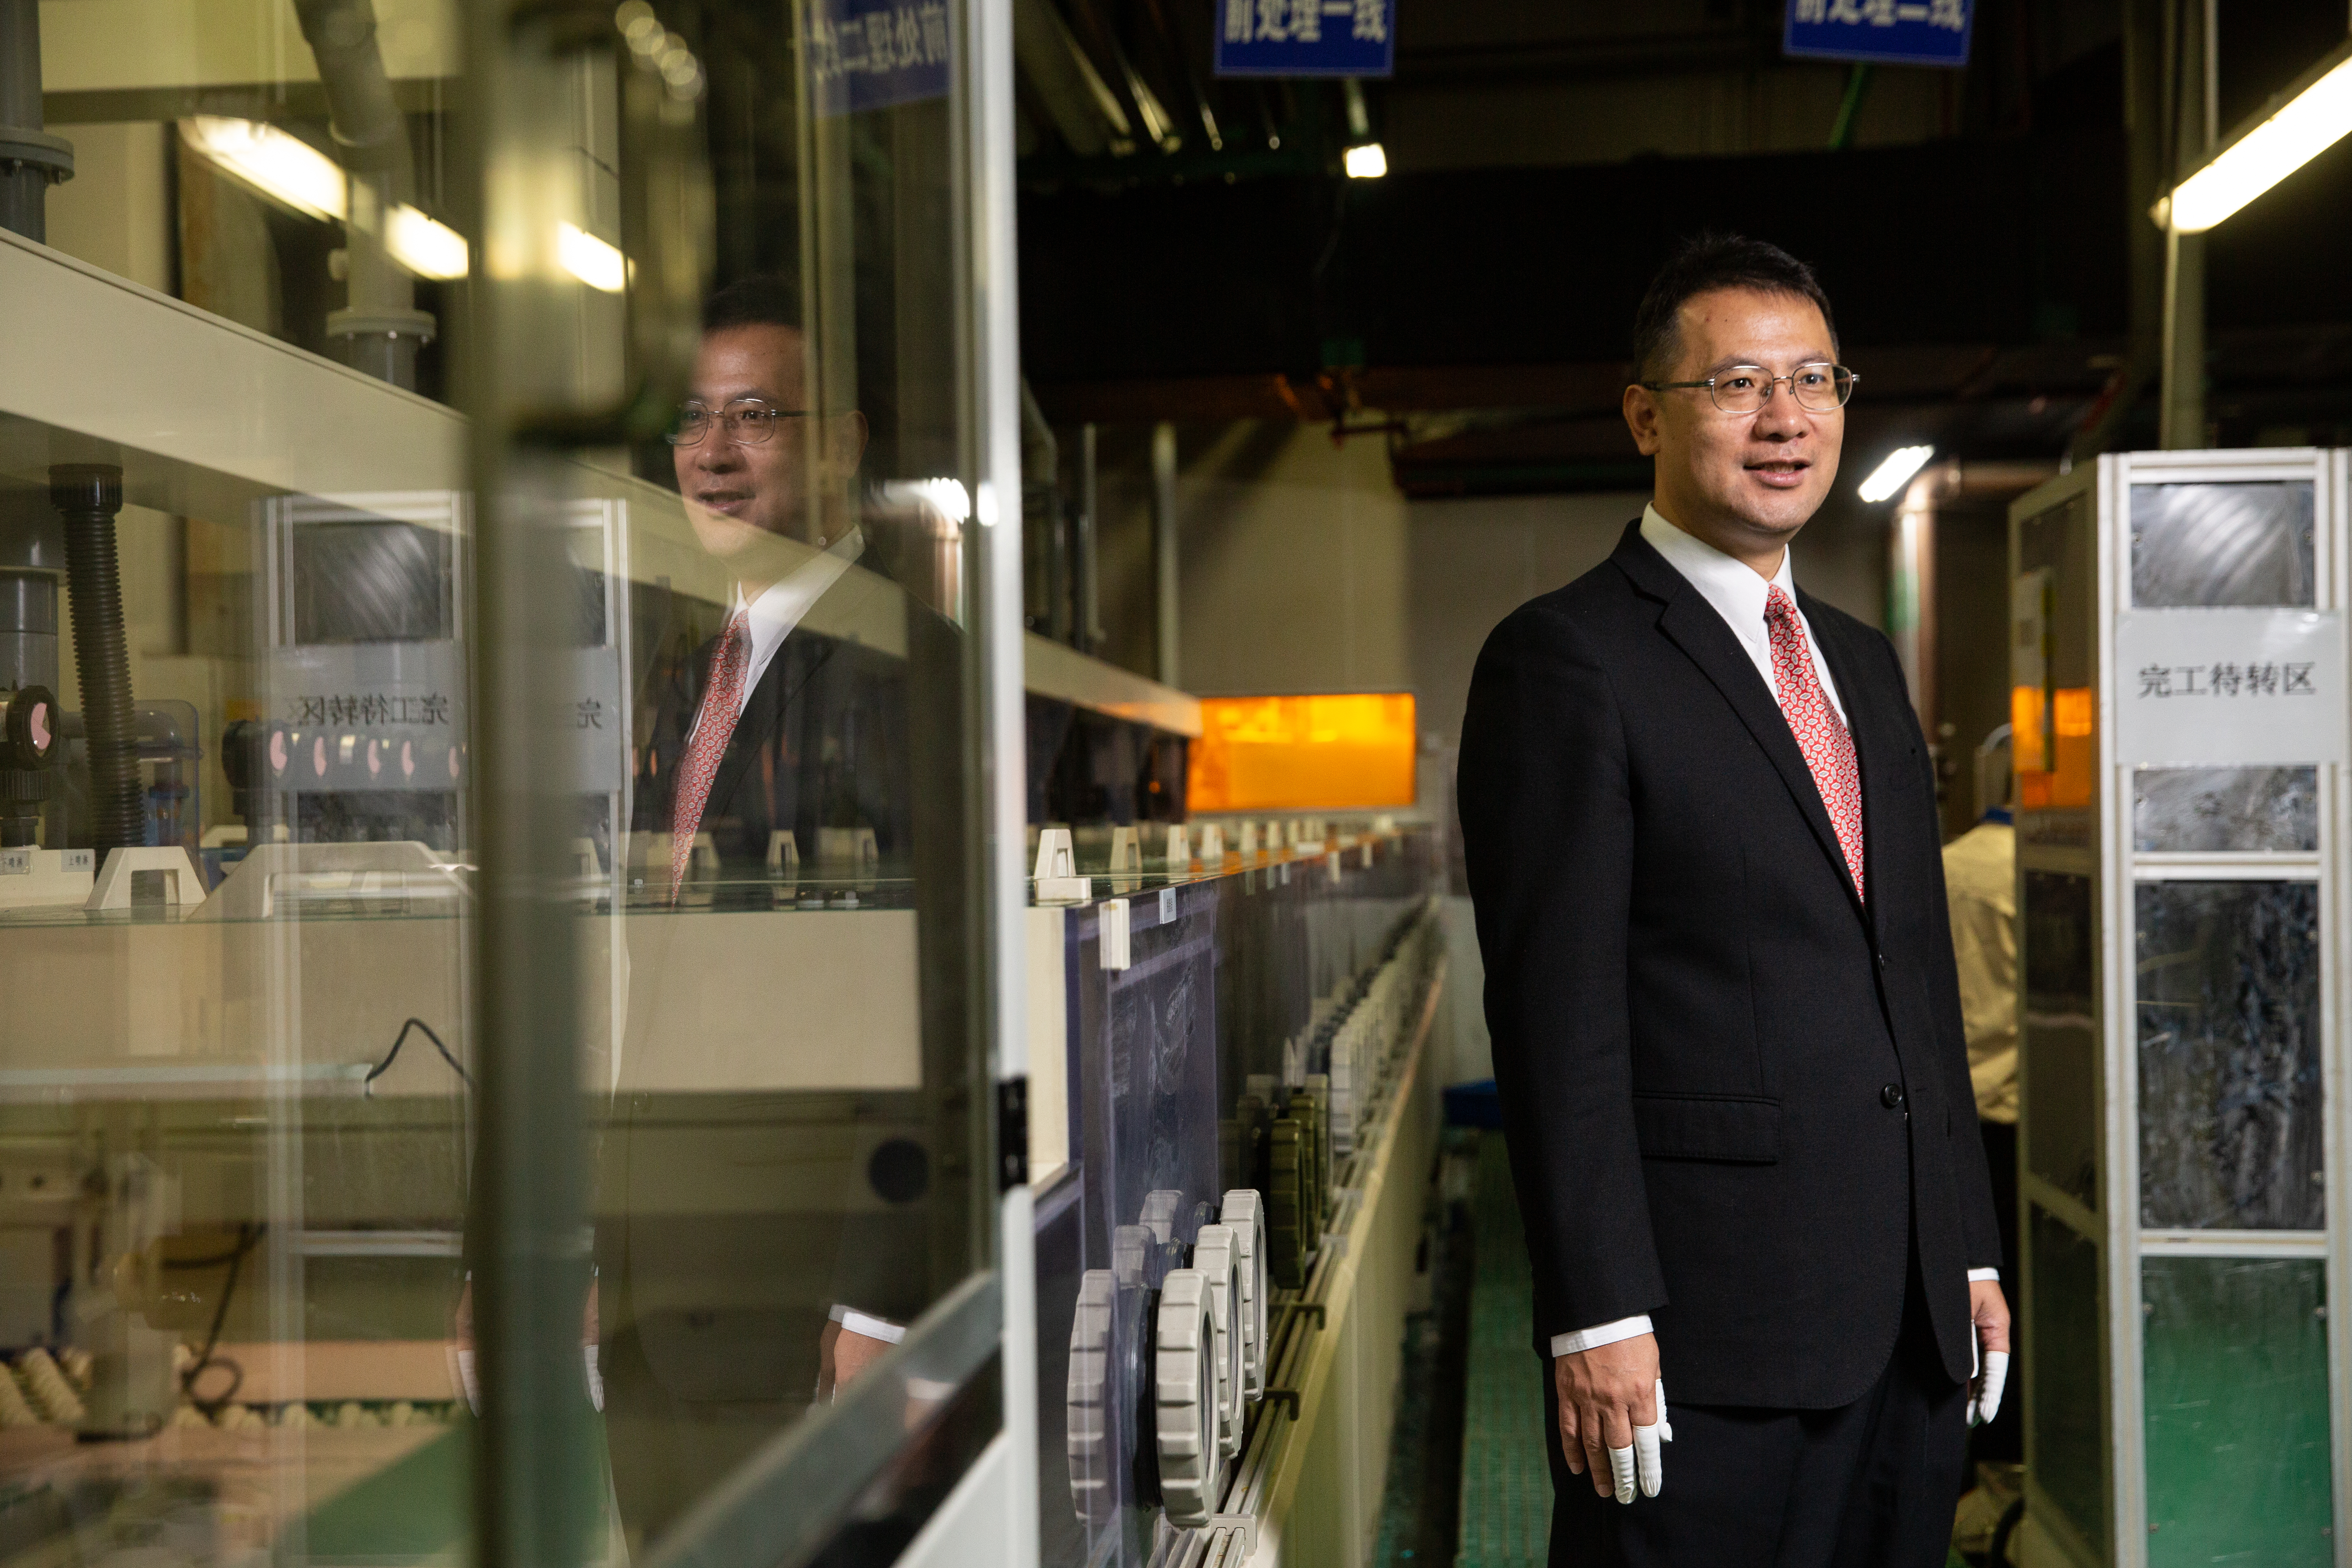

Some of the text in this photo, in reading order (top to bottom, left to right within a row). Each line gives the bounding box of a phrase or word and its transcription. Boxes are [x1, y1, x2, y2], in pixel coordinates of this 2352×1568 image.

[2138, 661, 2317, 698] 完工待转区
